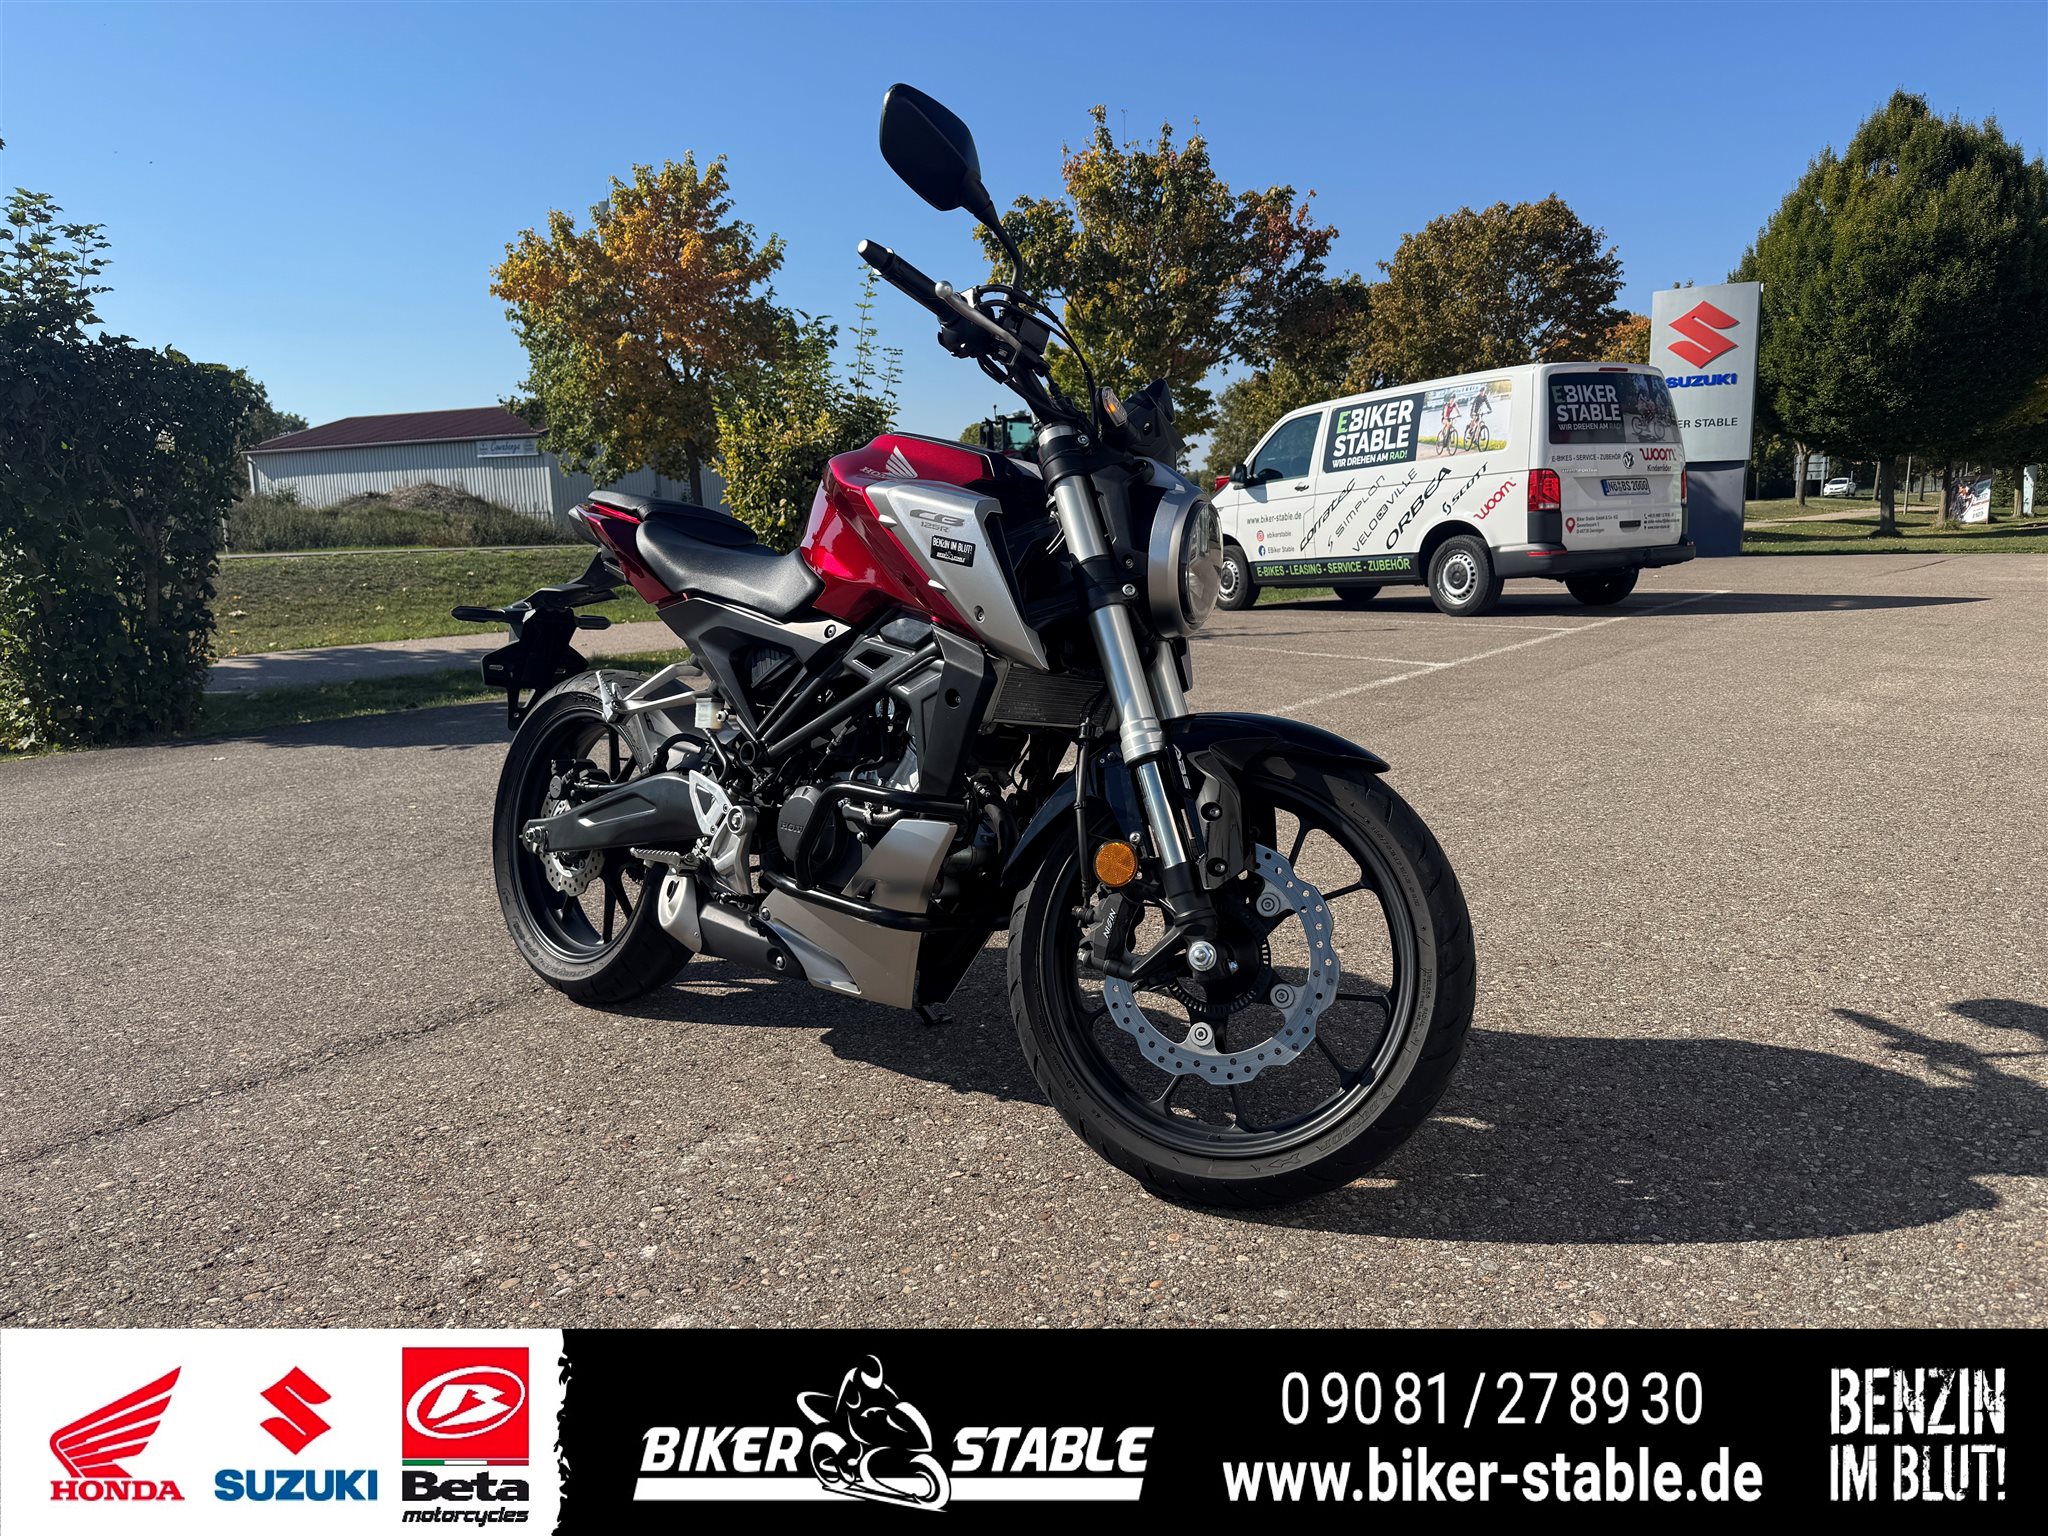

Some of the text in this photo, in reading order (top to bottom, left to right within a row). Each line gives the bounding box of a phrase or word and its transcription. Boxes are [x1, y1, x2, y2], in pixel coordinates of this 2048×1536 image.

[1665, 373, 1738, 389] SUZUKI
[1336, 399, 1414, 434] EBIKER
[1557, 404, 1622, 422] STABLE
[1677, 417, 1738, 429] ER STABLE
[1558, 423, 1572, 431] WIR
[1333, 424, 1411, 458] STABLE
[1332, 449, 1408, 468] WIR DREHEN AM RAD!
[1451, 461, 1488, 506] SCOTT
[1300, 478, 1355, 552] corratec
[1335, 475, 1386, 538] SIMPLON
[1386, 467, 1452, 550] ORBEA
[909, 509, 965, 527] CB
[1256, 565, 1285, 577] E-BIKES
[1290, 563, 1322, 575] LEASING
[1327, 560, 1362, 573] SERVICE
[1368, 556, 1411, 572] ZUBEHÖR
